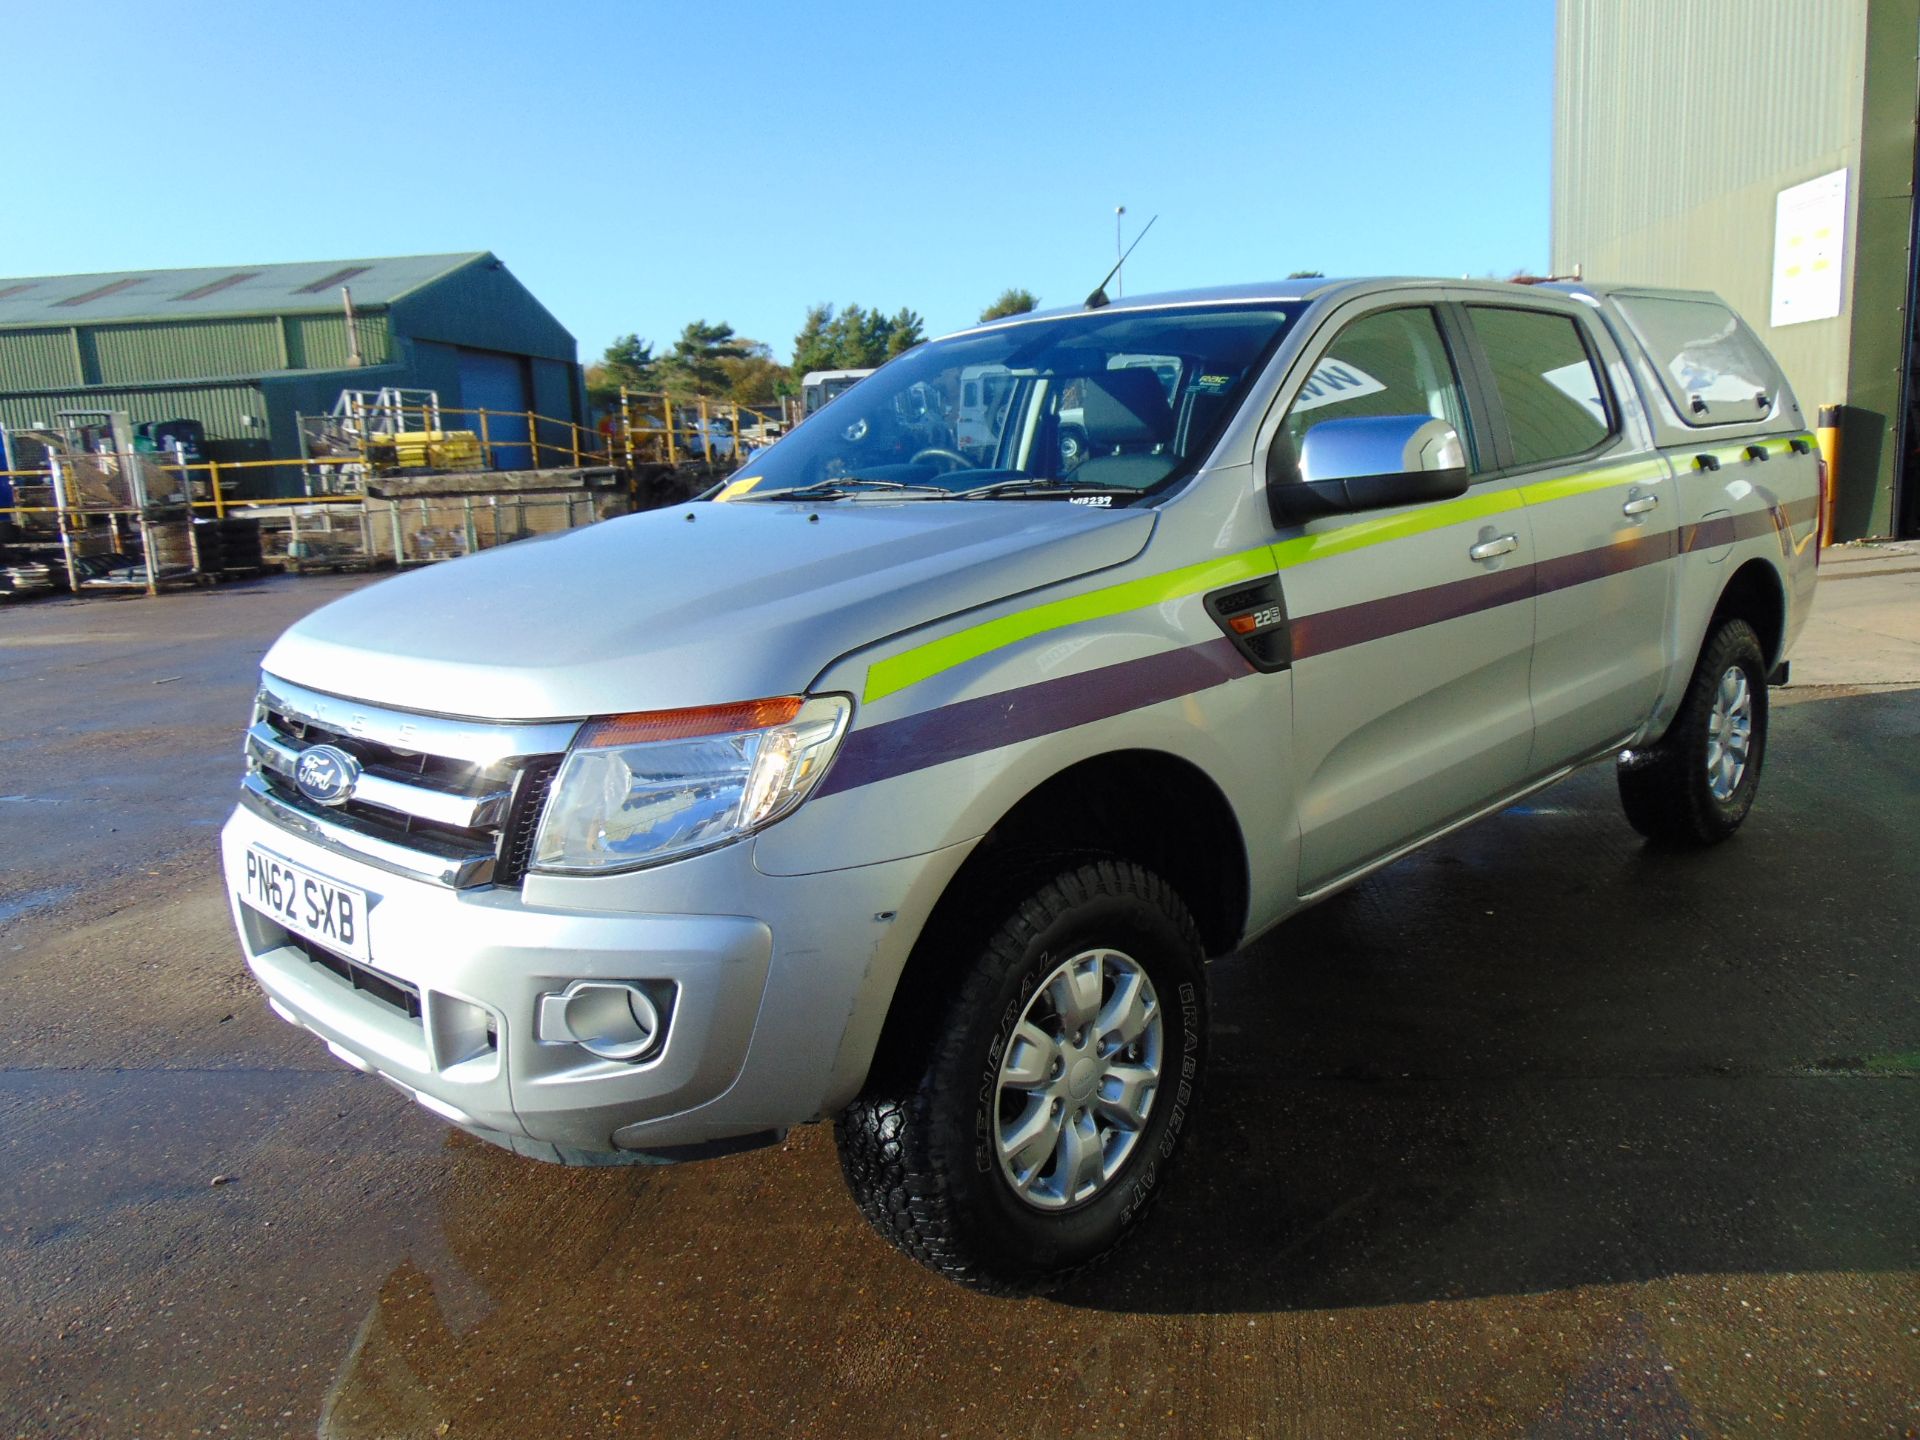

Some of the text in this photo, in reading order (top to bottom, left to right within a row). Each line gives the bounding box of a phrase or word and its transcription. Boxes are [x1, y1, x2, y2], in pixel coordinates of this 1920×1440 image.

[299, 755, 336, 791] Ford
[247, 849, 354, 946] PN62 SXB
[975, 950, 1057, 1173] GENERAL
[1159, 982, 1199, 1158] GRABBER
